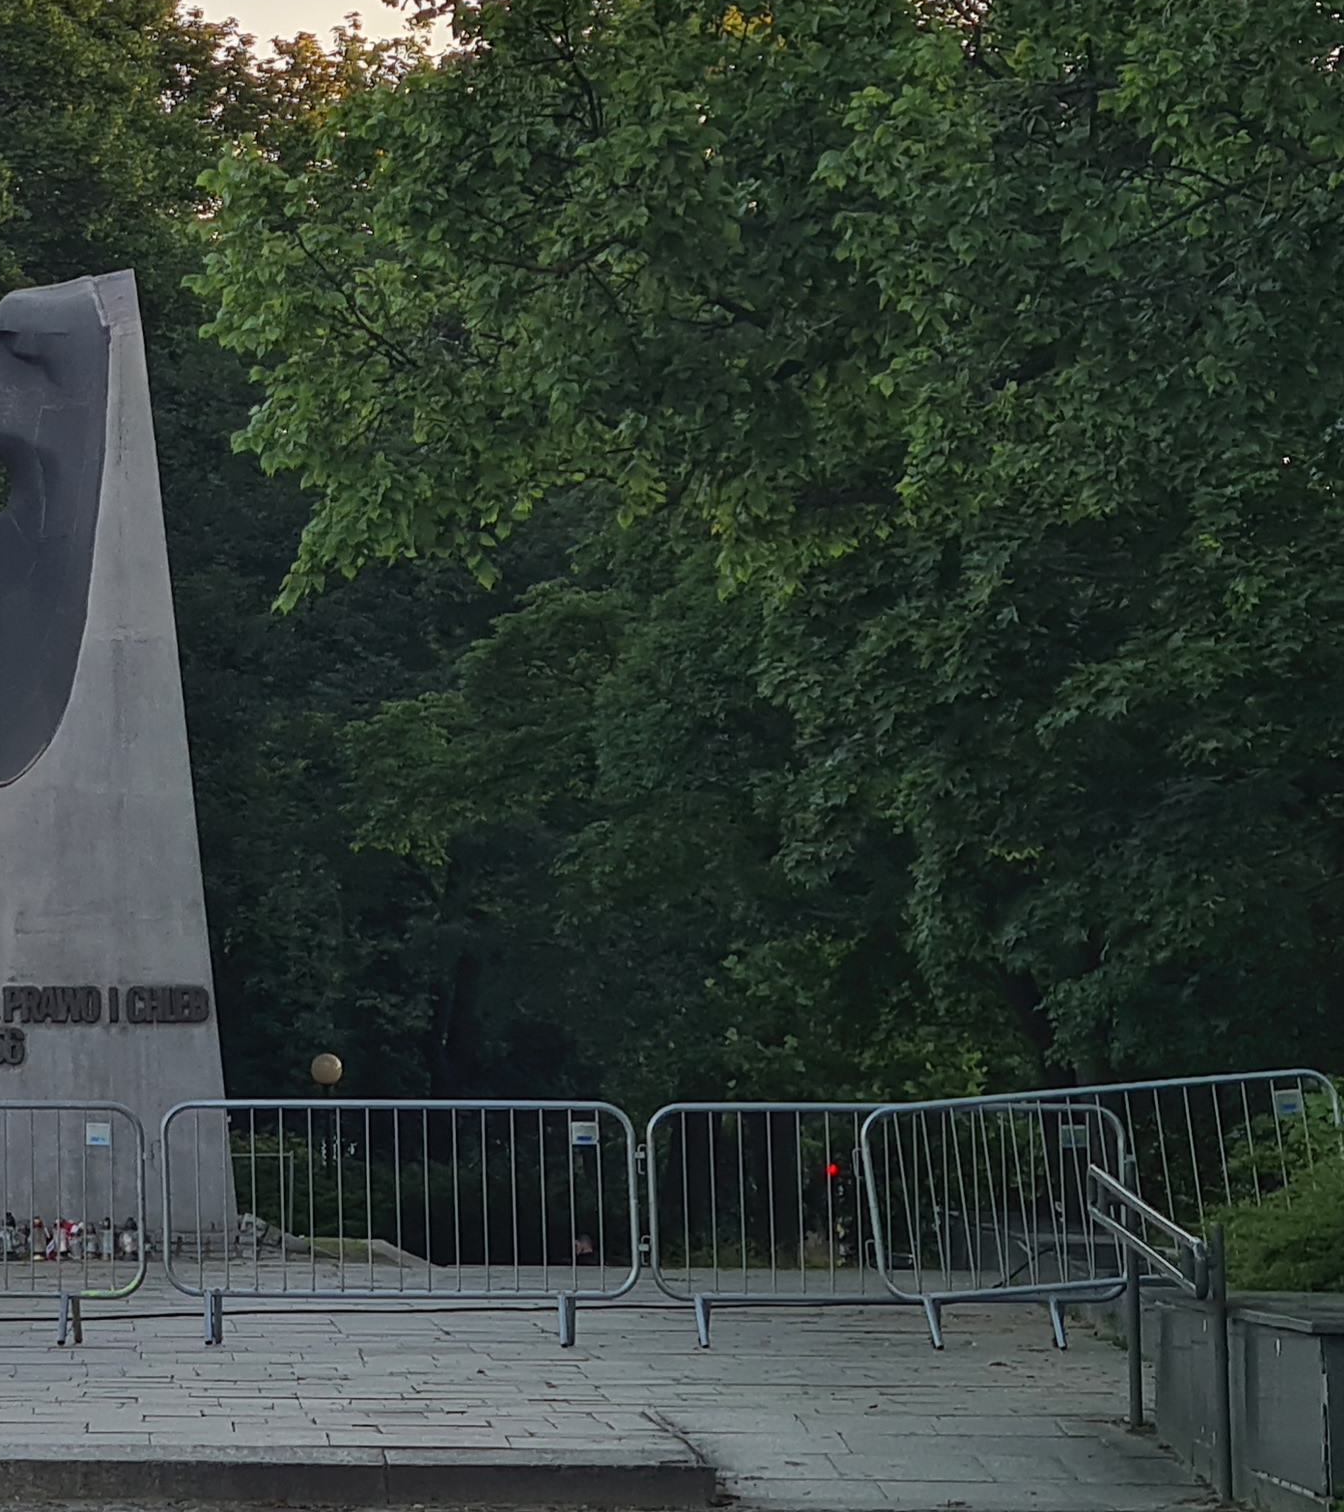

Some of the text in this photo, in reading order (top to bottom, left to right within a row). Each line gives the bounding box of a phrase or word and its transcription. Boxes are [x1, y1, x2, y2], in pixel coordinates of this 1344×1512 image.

[2, 986, 102, 1024] PRAWO
[110, 987, 120, 1024] I
[125, 986, 210, 1024] CHLEB
